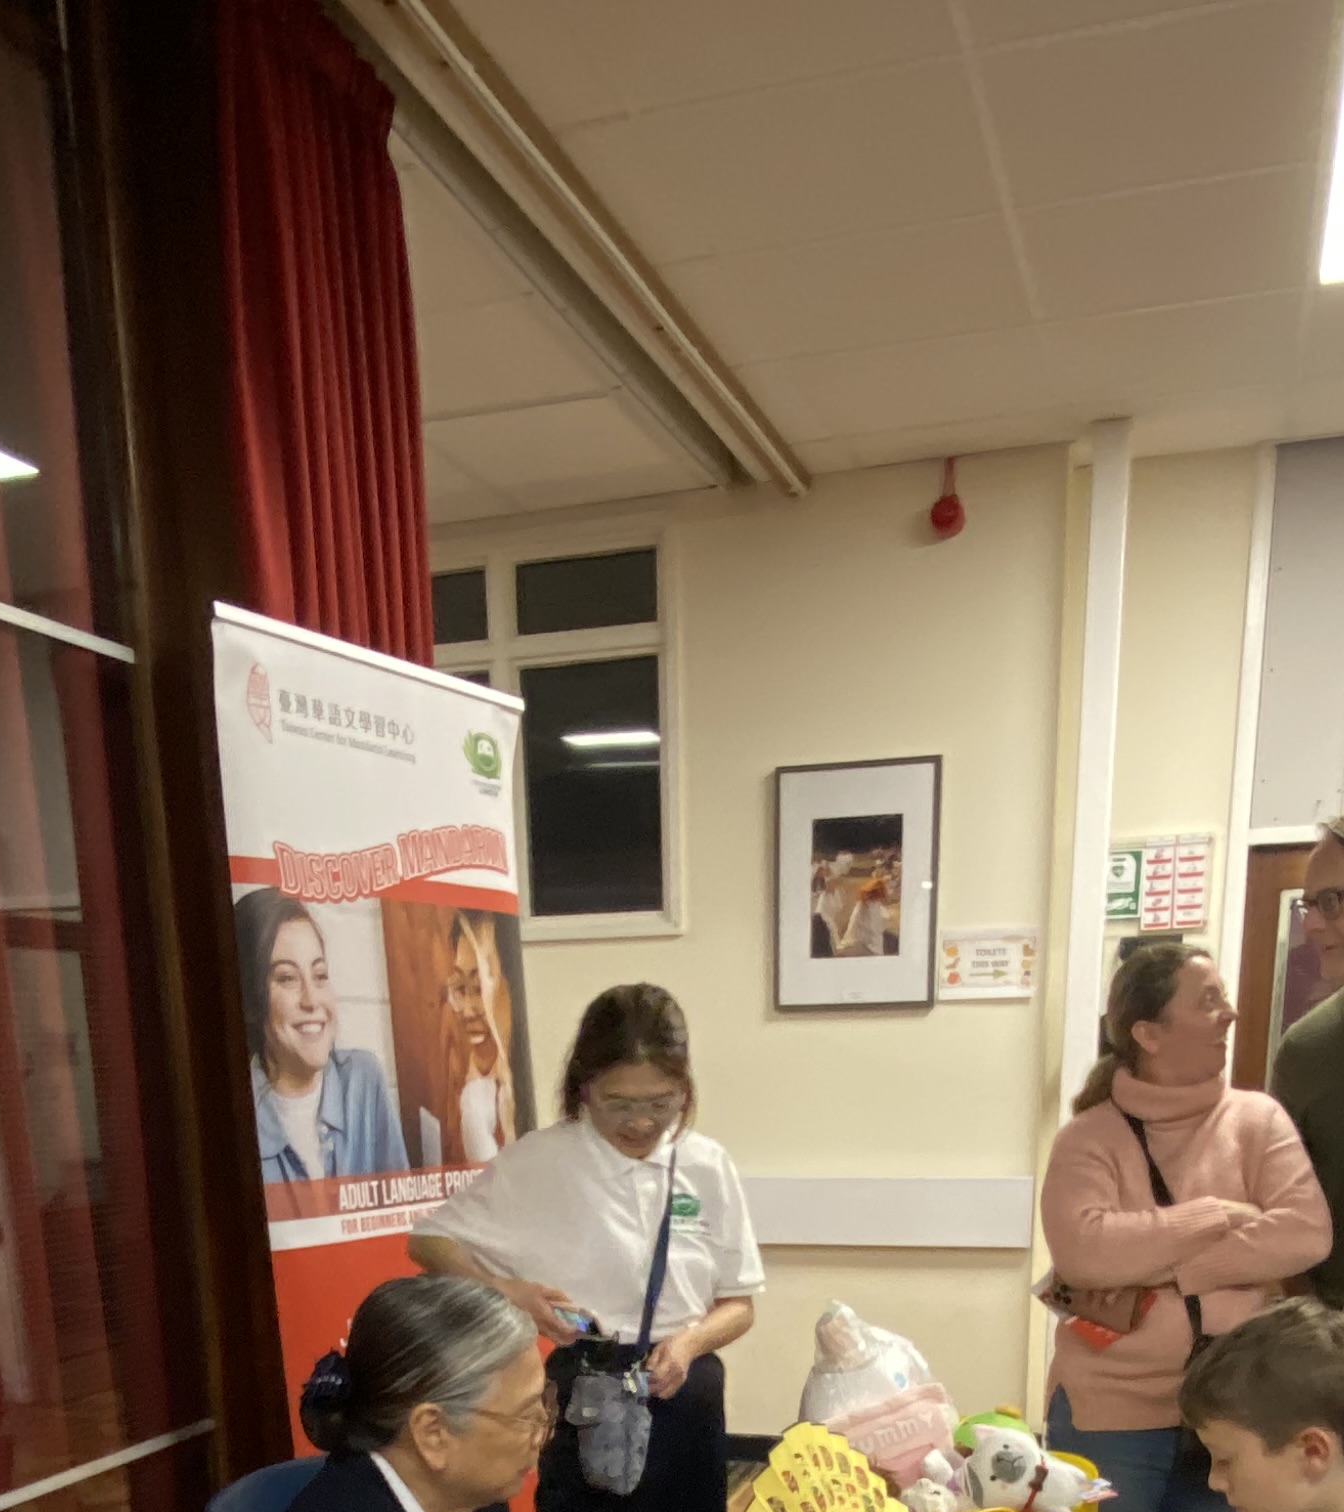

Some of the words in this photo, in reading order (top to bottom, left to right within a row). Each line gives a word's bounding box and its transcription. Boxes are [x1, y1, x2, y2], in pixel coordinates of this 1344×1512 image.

[279, 690, 415, 745] 臺灣華語文學習中心
[273, 841, 401, 904] DISCOVER
[397, 825, 509, 882] MANDARIN
[339, 1180, 379, 1211] ADULT
[382, 1173, 443, 1205] LANGUAGE
